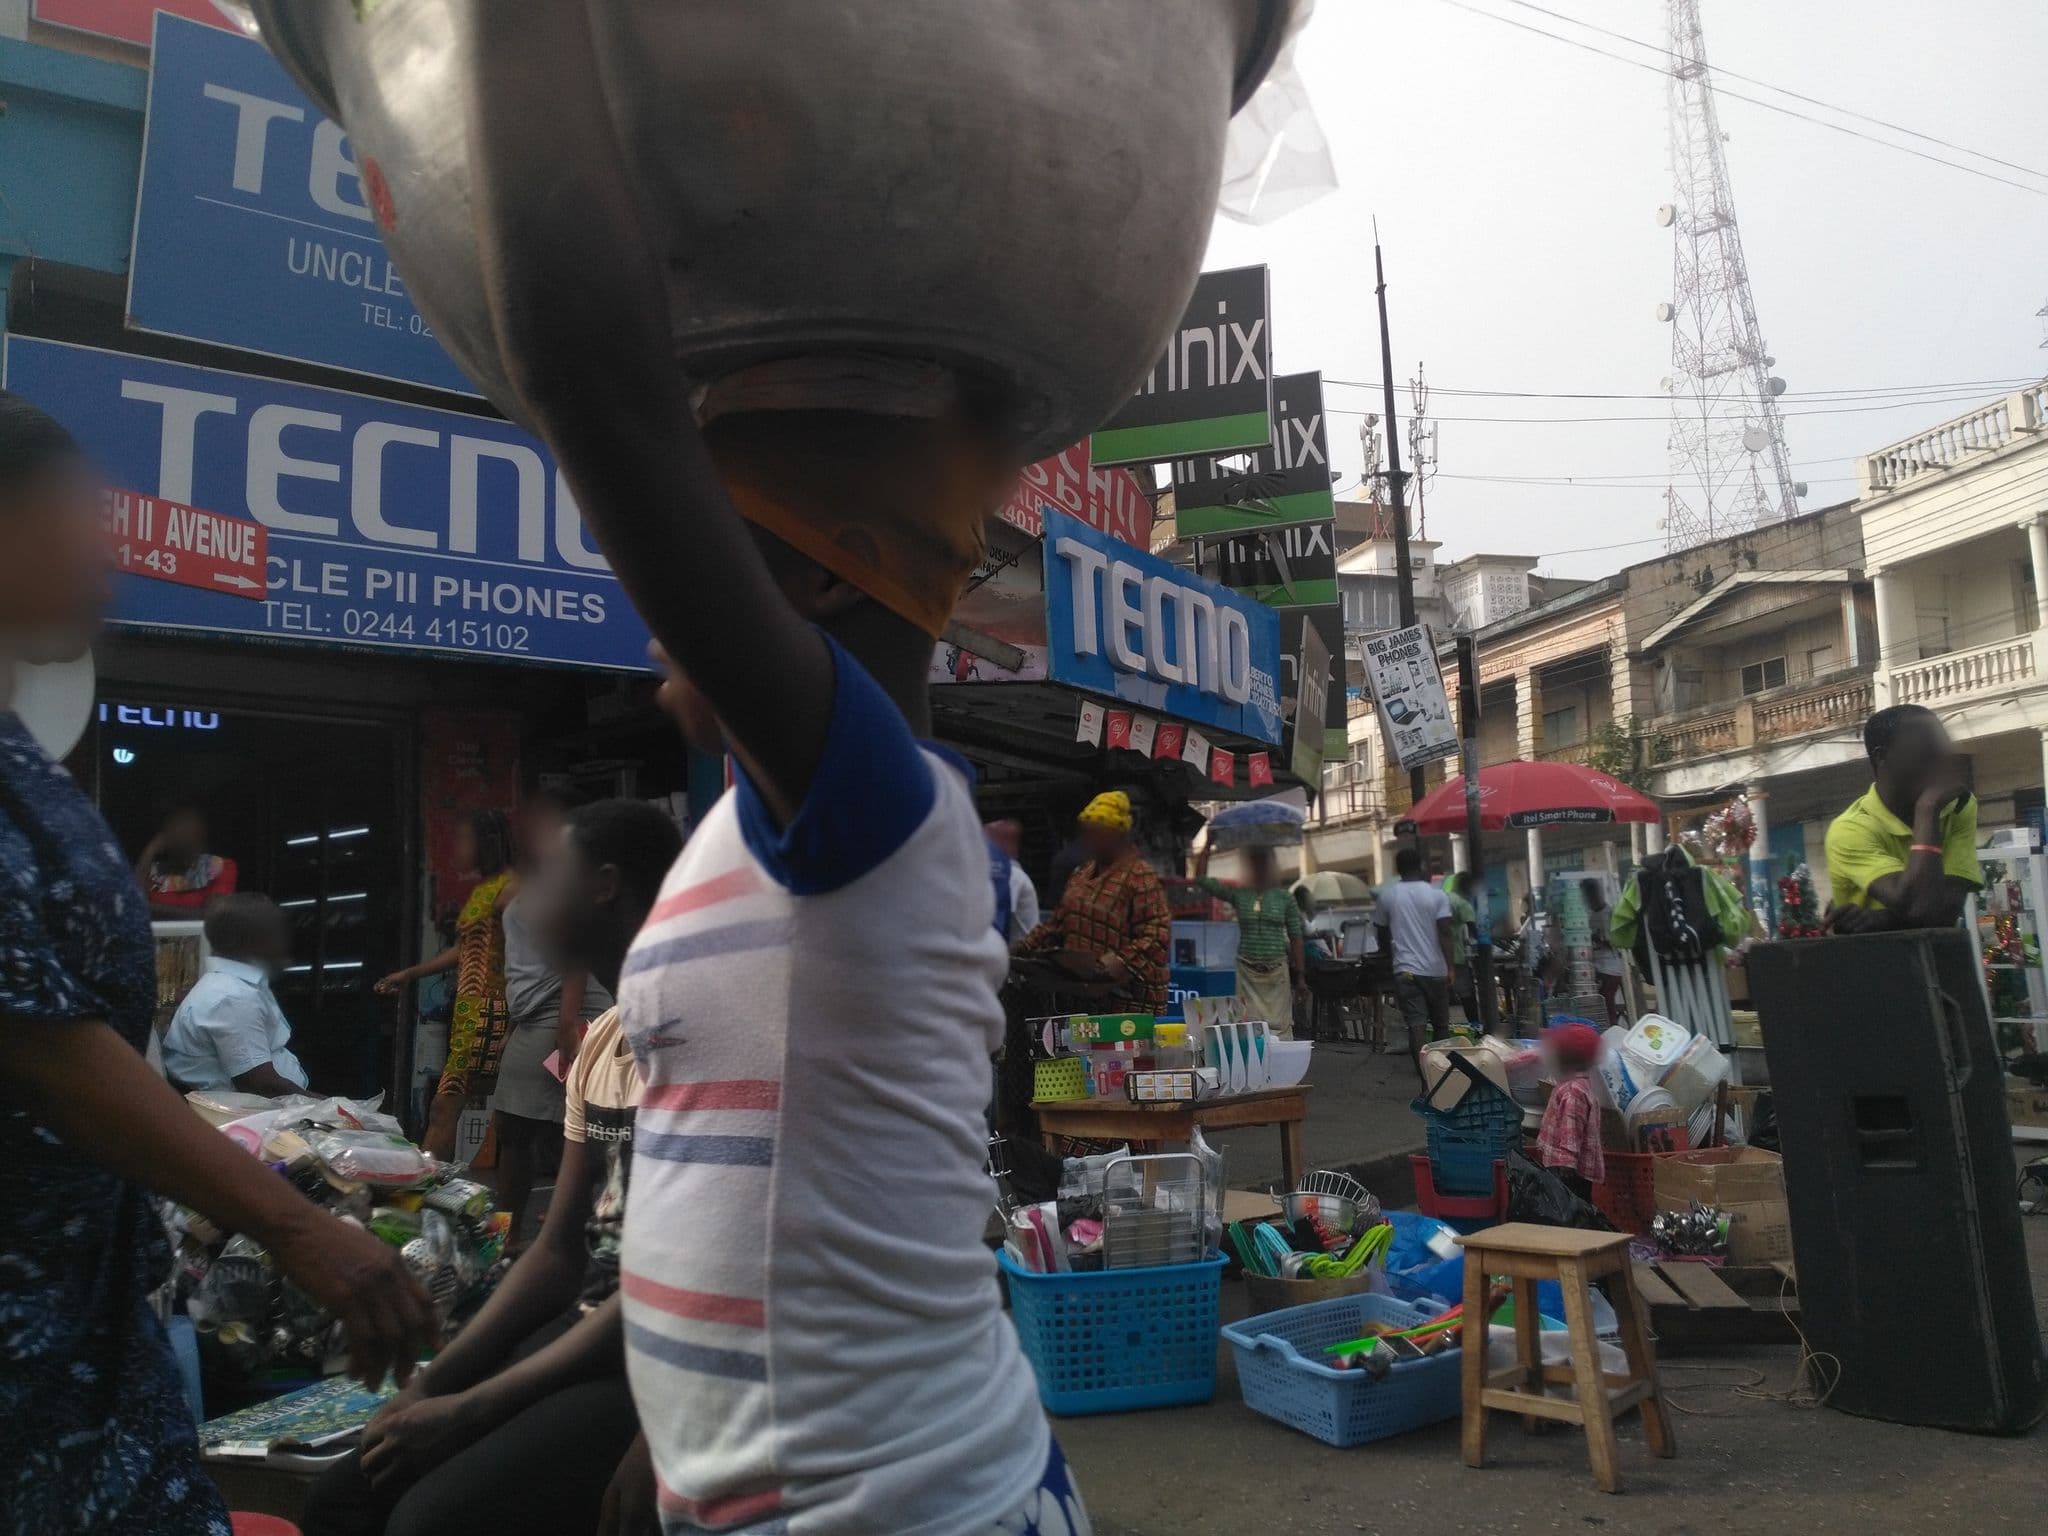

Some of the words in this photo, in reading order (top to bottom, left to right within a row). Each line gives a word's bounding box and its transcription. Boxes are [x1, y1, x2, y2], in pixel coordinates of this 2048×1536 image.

[204, 82, 375, 222] TE
[288, 238, 403, 296] UNCLE
[361, 303, 403, 330] TEL:
[165, 507, 256, 565] AVENUE
[266, 555, 349, 596] CLE
[366, 567, 417, 604] PII
[433, 575, 606, 624] PHONES
[258, 600, 331, 632] TEL:
[343, 608, 415, 640] 0244
[425, 617, 529, 651] 415102
[1055, 537, 1250, 705] TECNO
[1367, 639, 1388, 656] BIG
[1388, 628, 1423, 649] JAMES
[1377, 643, 1422, 668] PHONES
